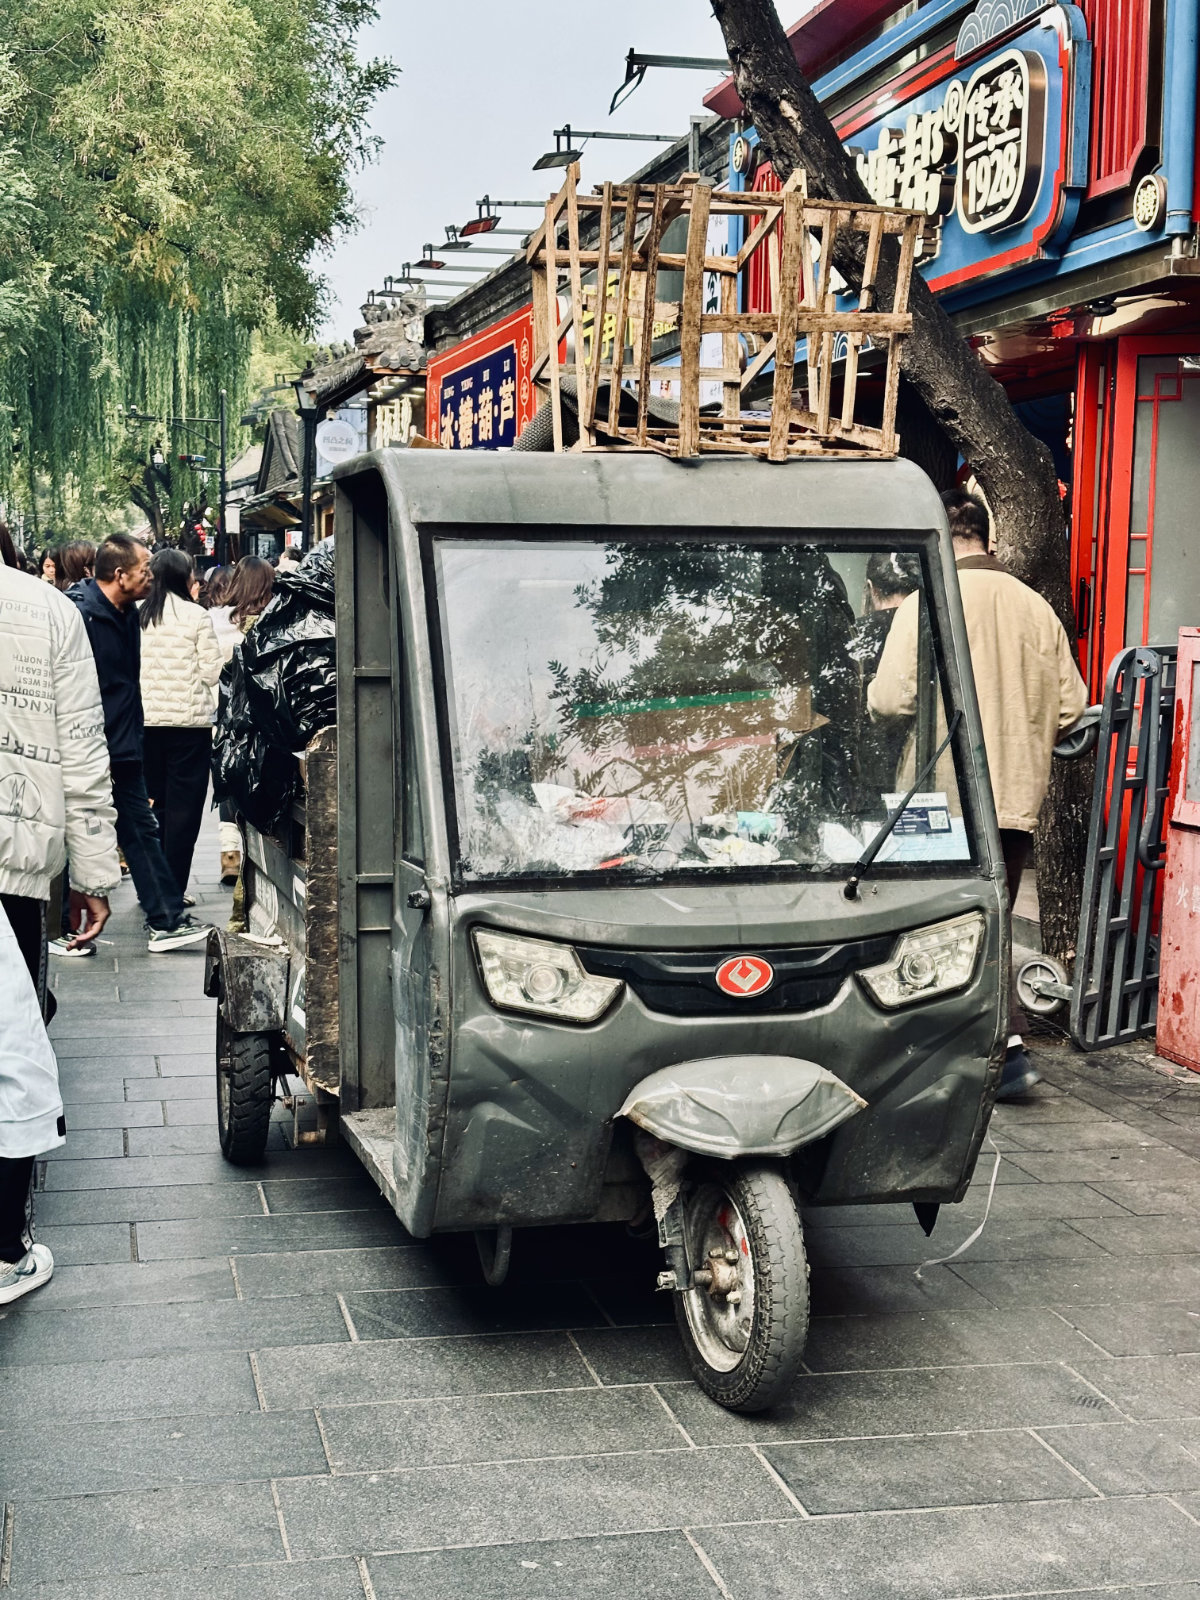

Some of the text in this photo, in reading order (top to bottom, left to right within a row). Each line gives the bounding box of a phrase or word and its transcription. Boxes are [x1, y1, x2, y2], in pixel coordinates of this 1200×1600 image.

[965, 70, 1025, 143] 传承
[965, 142, 1018, 215] 1928
[12, 654, 42, 664] NORTH
[17, 676, 41, 687] WEST
